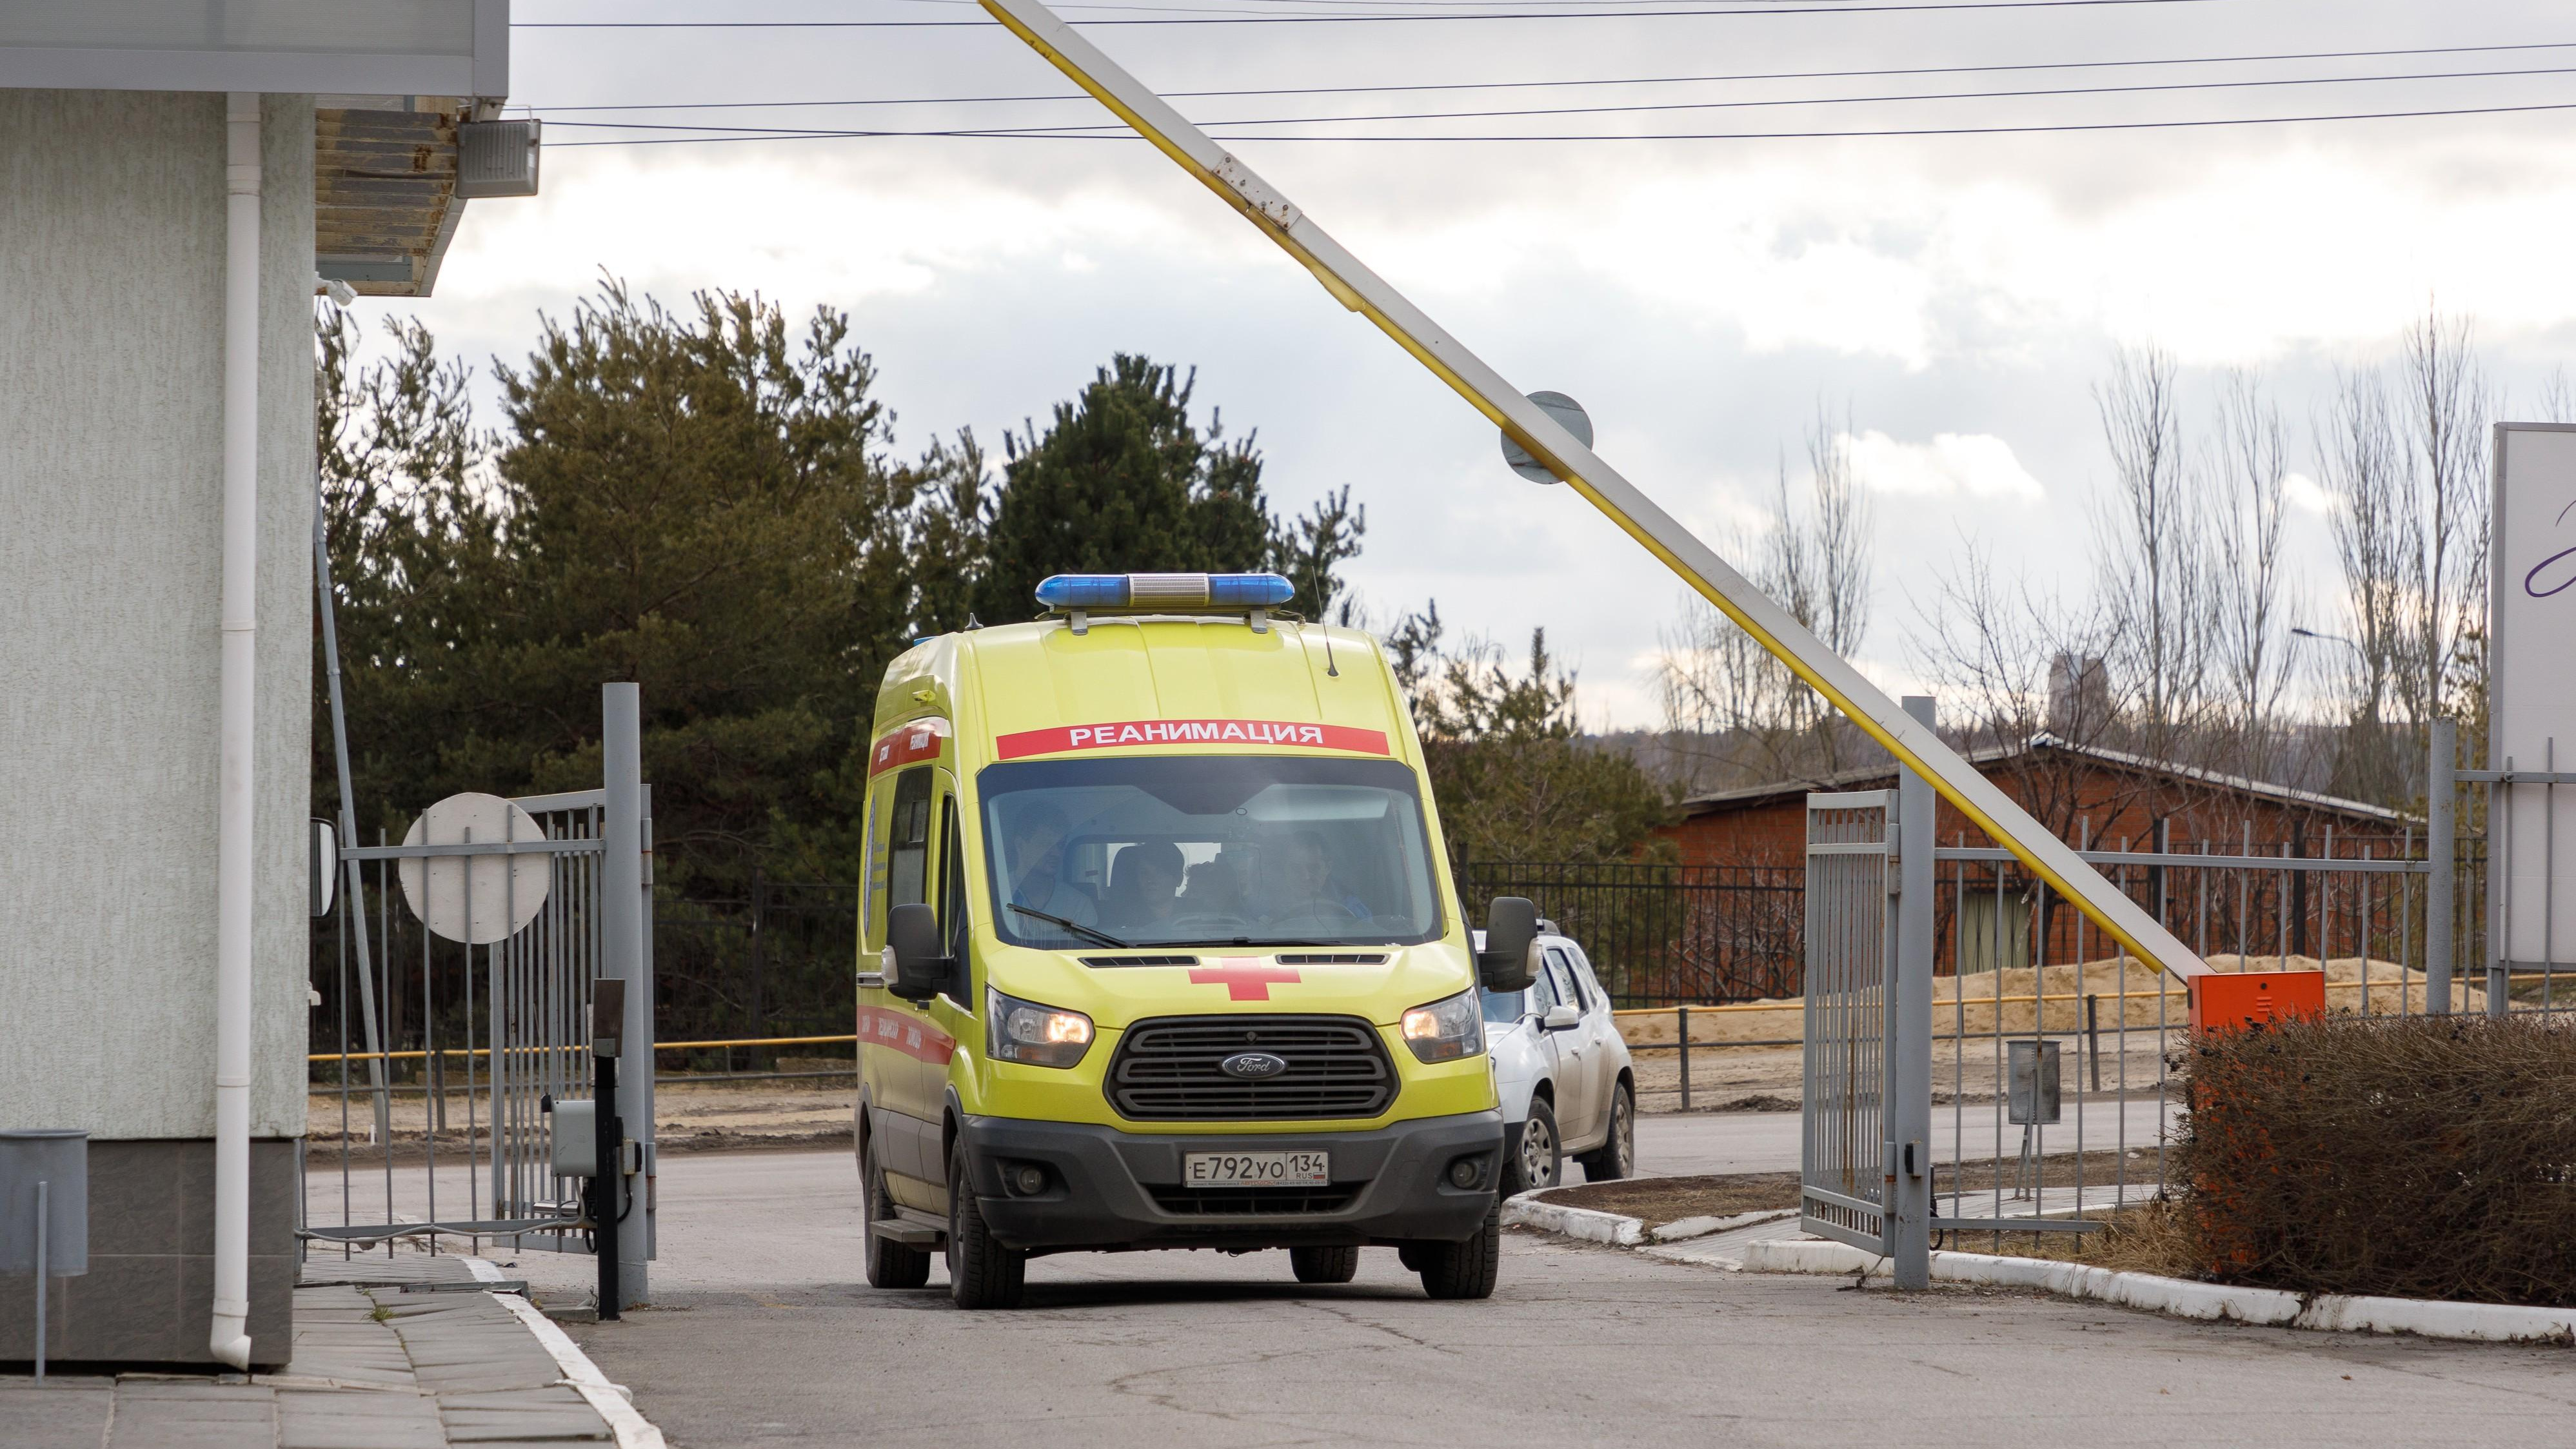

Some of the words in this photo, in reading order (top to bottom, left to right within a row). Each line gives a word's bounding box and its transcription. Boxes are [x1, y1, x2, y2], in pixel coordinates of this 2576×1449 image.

[1069, 723, 1323, 746] РЕАНИМАЦИЯ
[1237, 1058, 1271, 1072] Ford
[1289, 1155, 1323, 1172] 134
